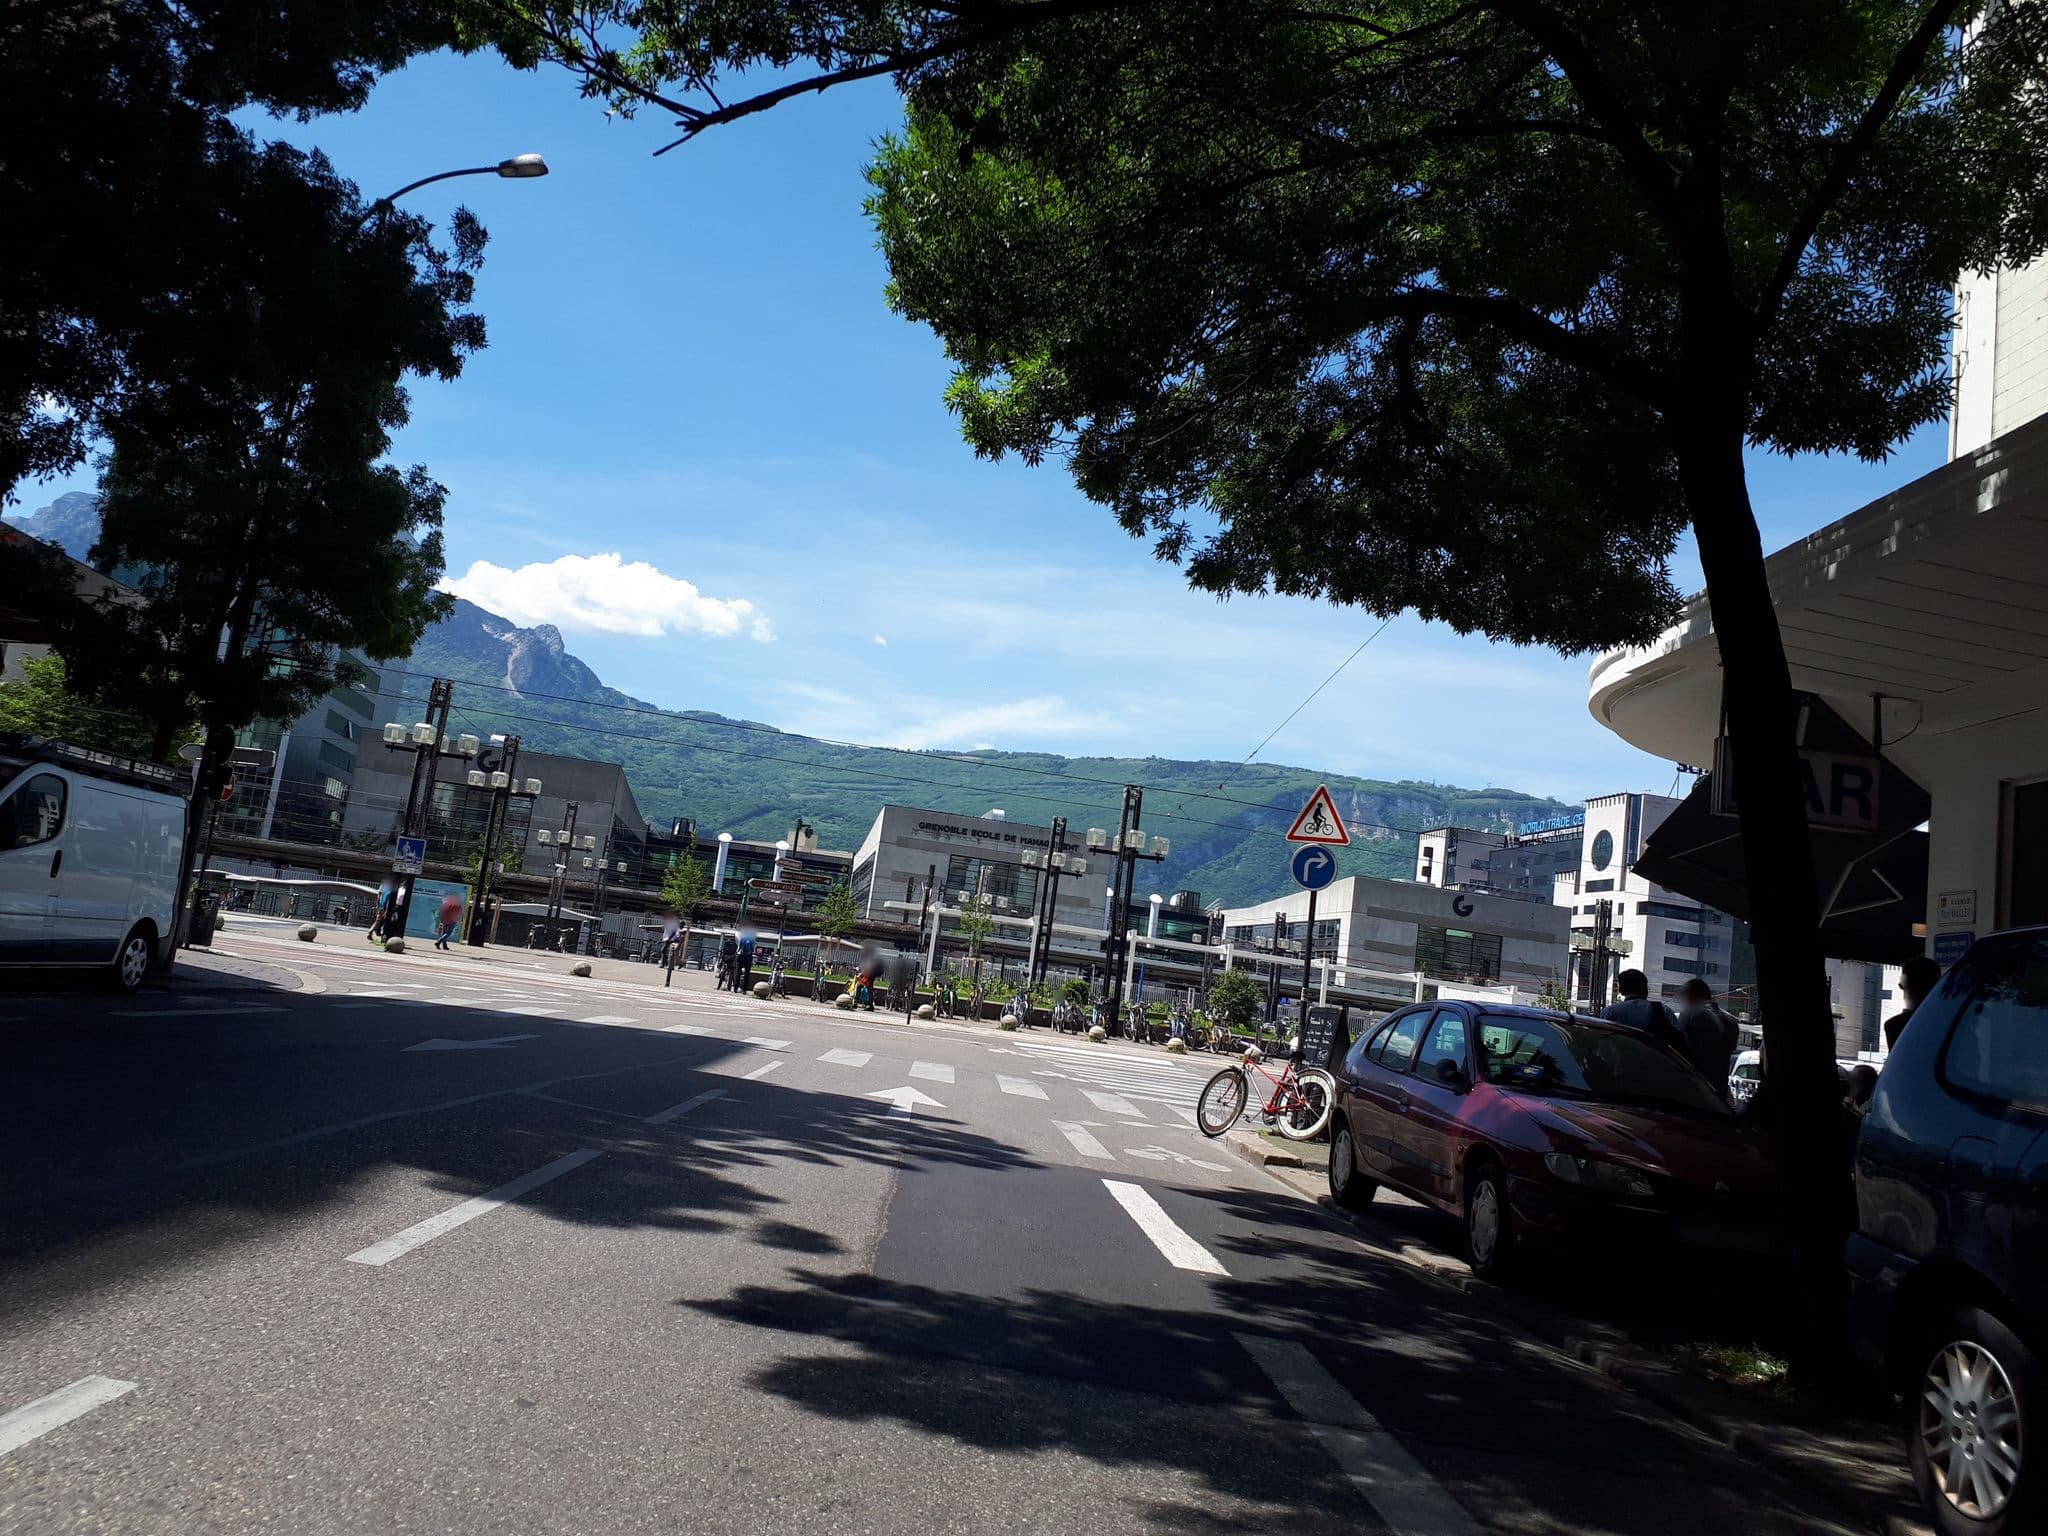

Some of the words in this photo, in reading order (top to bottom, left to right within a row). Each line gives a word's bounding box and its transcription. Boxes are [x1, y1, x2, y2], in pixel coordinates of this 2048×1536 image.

[918, 821, 967, 836] GRENOBLE
[971, 828, 1000, 841] ECOLE
[1004, 834, 1016, 843] DE
[1520, 820, 1545, 835] WORLD
[1548, 815, 1570, 830] TRADE
